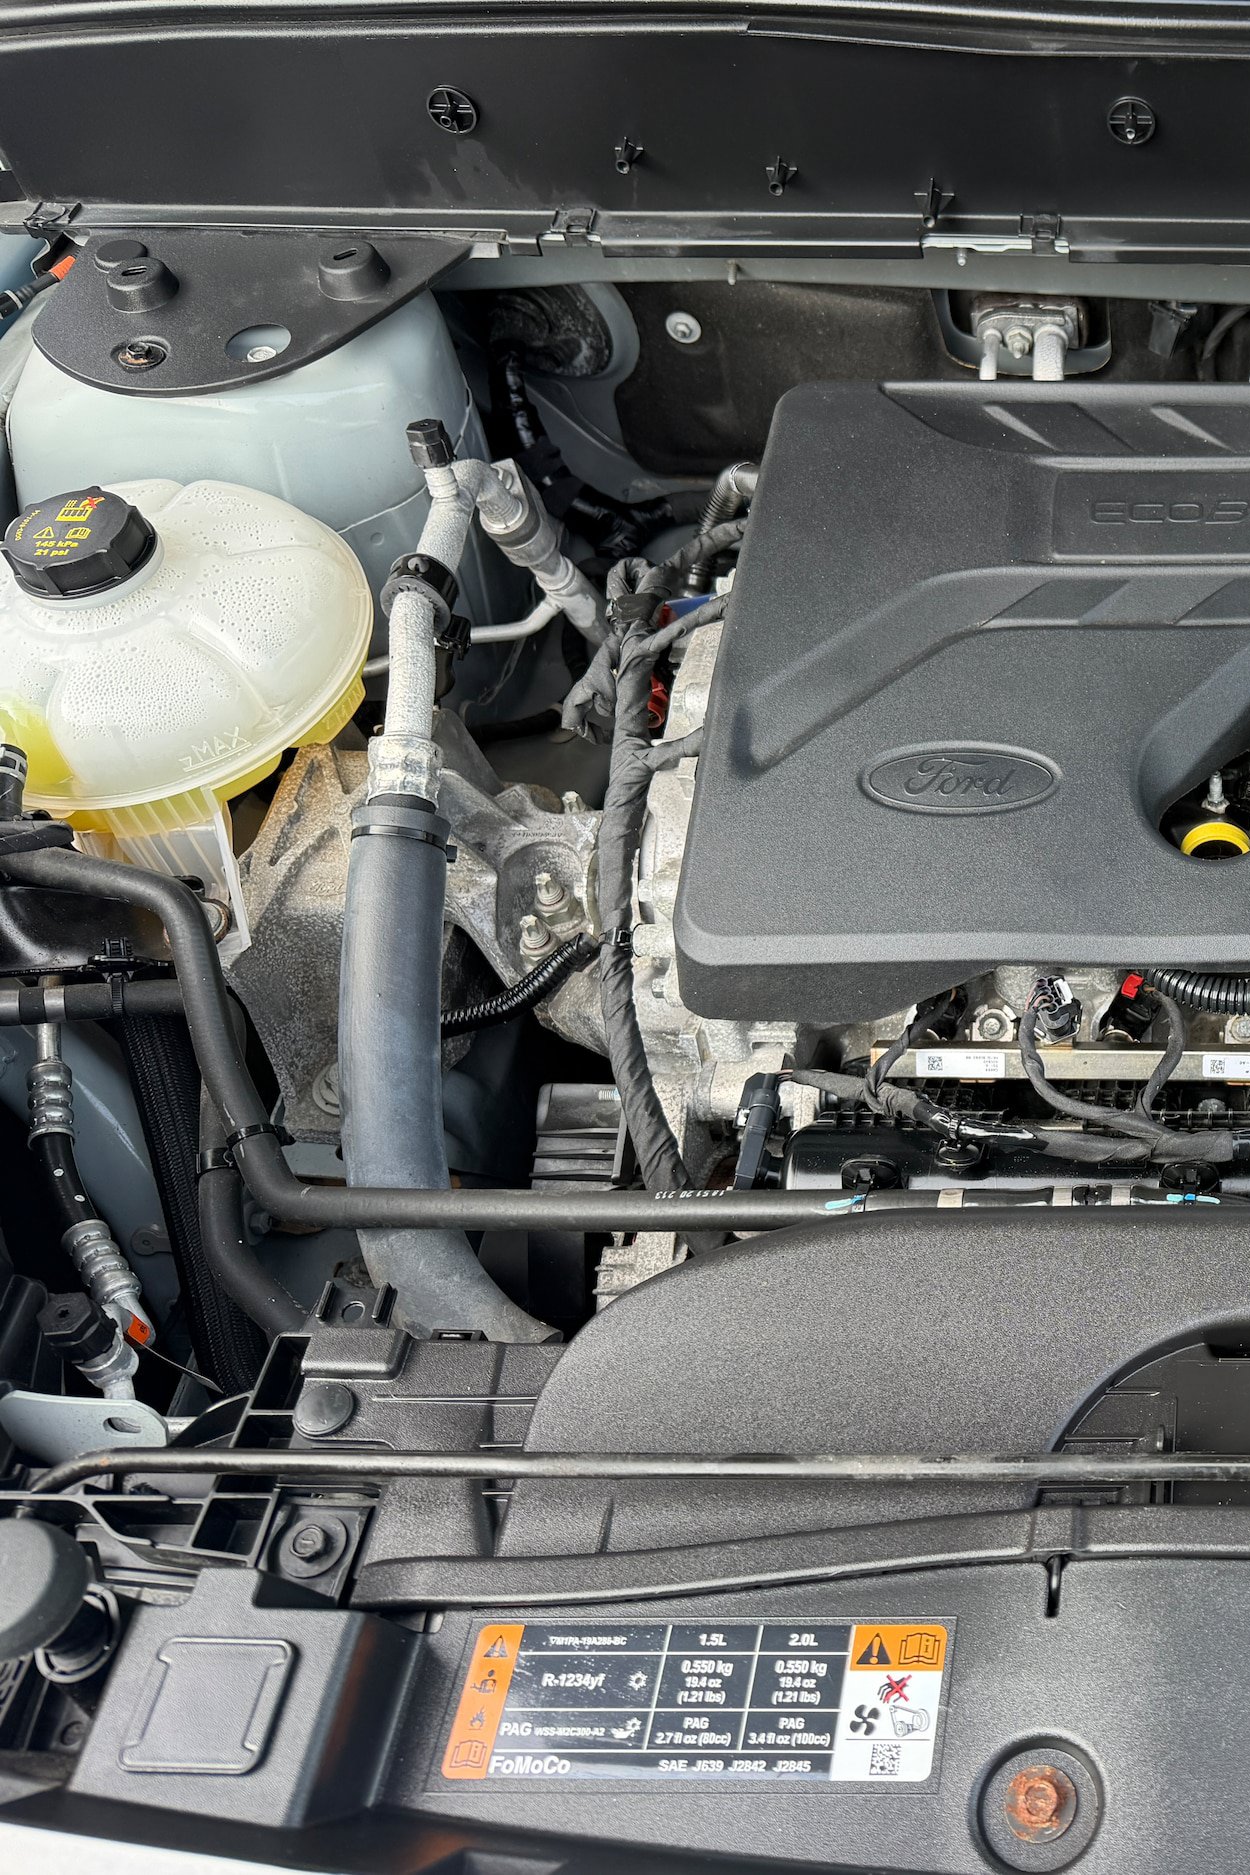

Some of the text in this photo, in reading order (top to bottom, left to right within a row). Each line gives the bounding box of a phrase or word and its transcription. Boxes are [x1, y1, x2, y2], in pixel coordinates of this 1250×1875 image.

[50, 549, 70, 557] psi
[190, 726, 248, 755] MAX
[903, 757, 1017, 797] Ford
[655, 1191, 677, 1200] 213
[699, 1633, 727, 1646] 1.5L
[788, 1633, 819, 1647] 2.0L
[681, 1660, 734, 1677] 0.550 kg
[774, 1660, 828, 1677] 0.550 kg
[541, 1673, 607, 1690] R-1234yf
[684, 1676, 722, 1688] 19.4 oz
[778, 1676, 817, 1688] 19.4 oz
[677, 1690, 726, 1705] (1.21 lbs)
[771, 1690, 821, 1705] (1.21 lbs)
[500, 1722, 533, 1737] PAG
[683, 1716, 710, 1729] PAG
[778, 1717, 805, 1729] PAG
[655, 1732, 732, 1747] 2.7 fl oz (80cc)
[748, 1732, 831, 1747] 3.4 fl oz (100cc)
[488, 1756, 812, 1775] FoMoCo SAE J639 J2842 J2845
